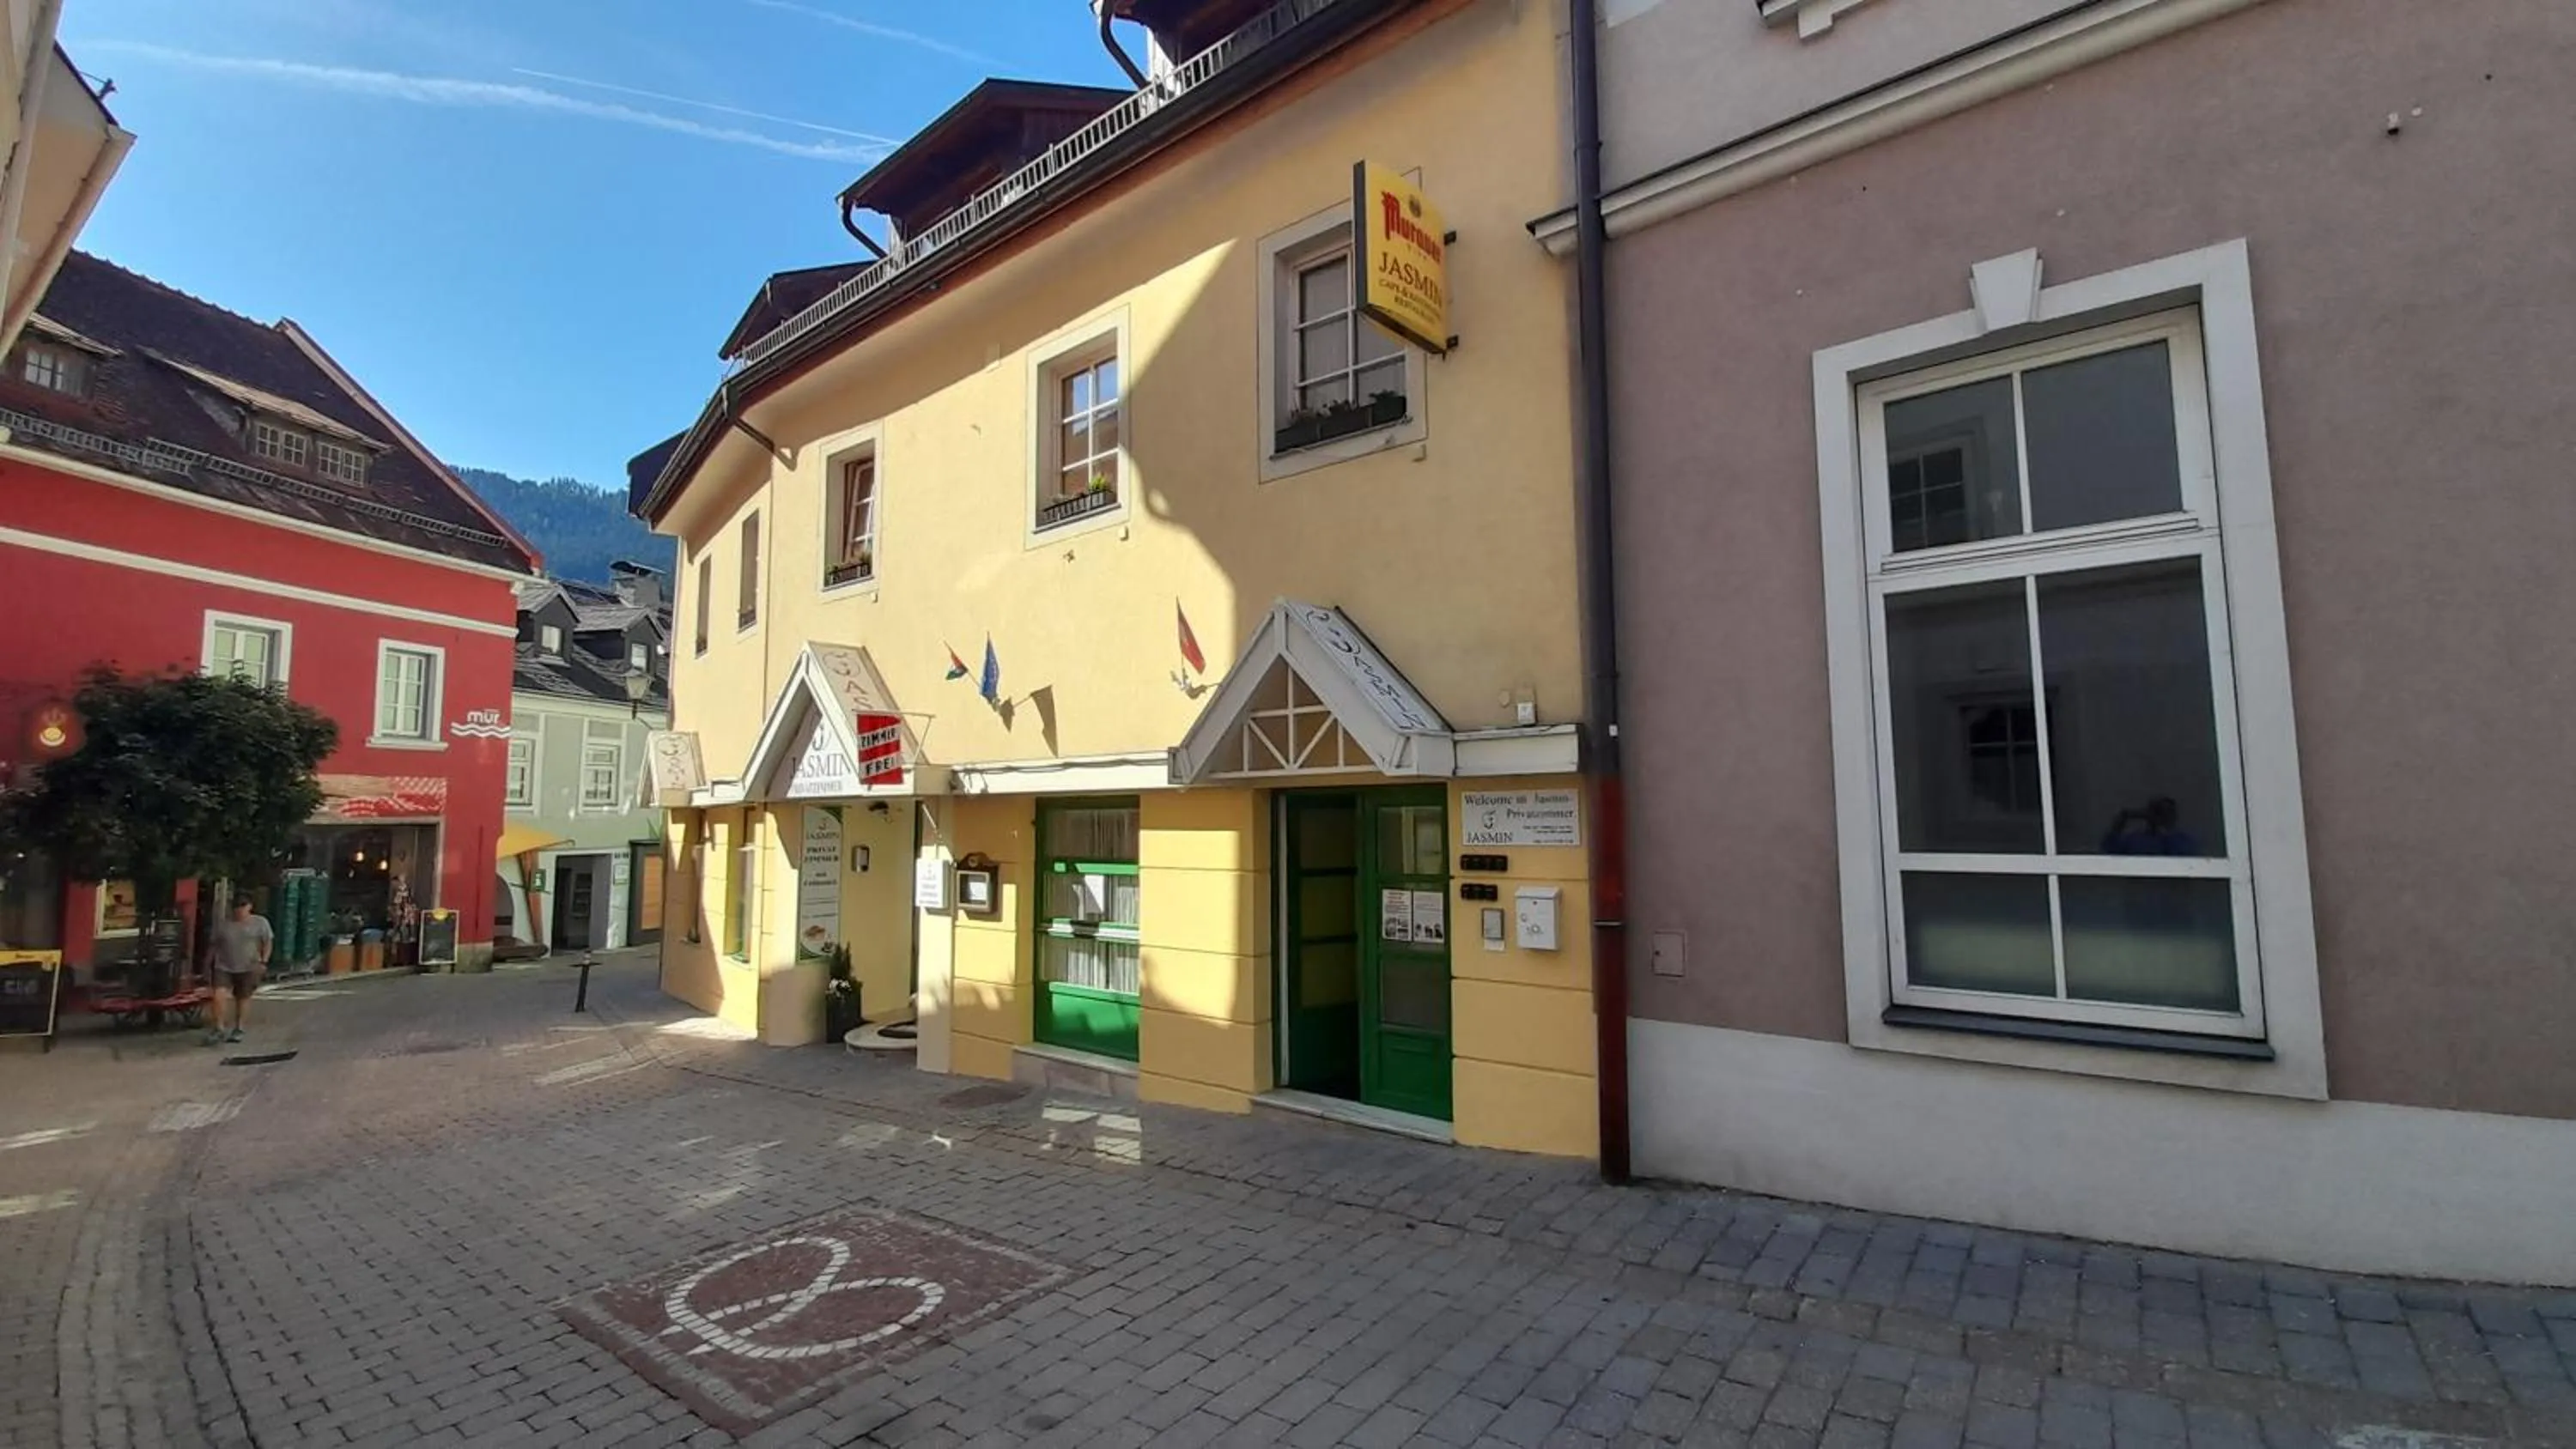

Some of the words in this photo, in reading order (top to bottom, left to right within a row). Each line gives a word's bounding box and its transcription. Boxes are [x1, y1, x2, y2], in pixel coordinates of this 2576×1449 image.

[1379, 251, 1443, 310] JASMIN
[789, 754, 851, 779] JASMIN
[1464, 793, 1513, 805] Welcome
[1467, 831, 1514, 843] JASMIN
